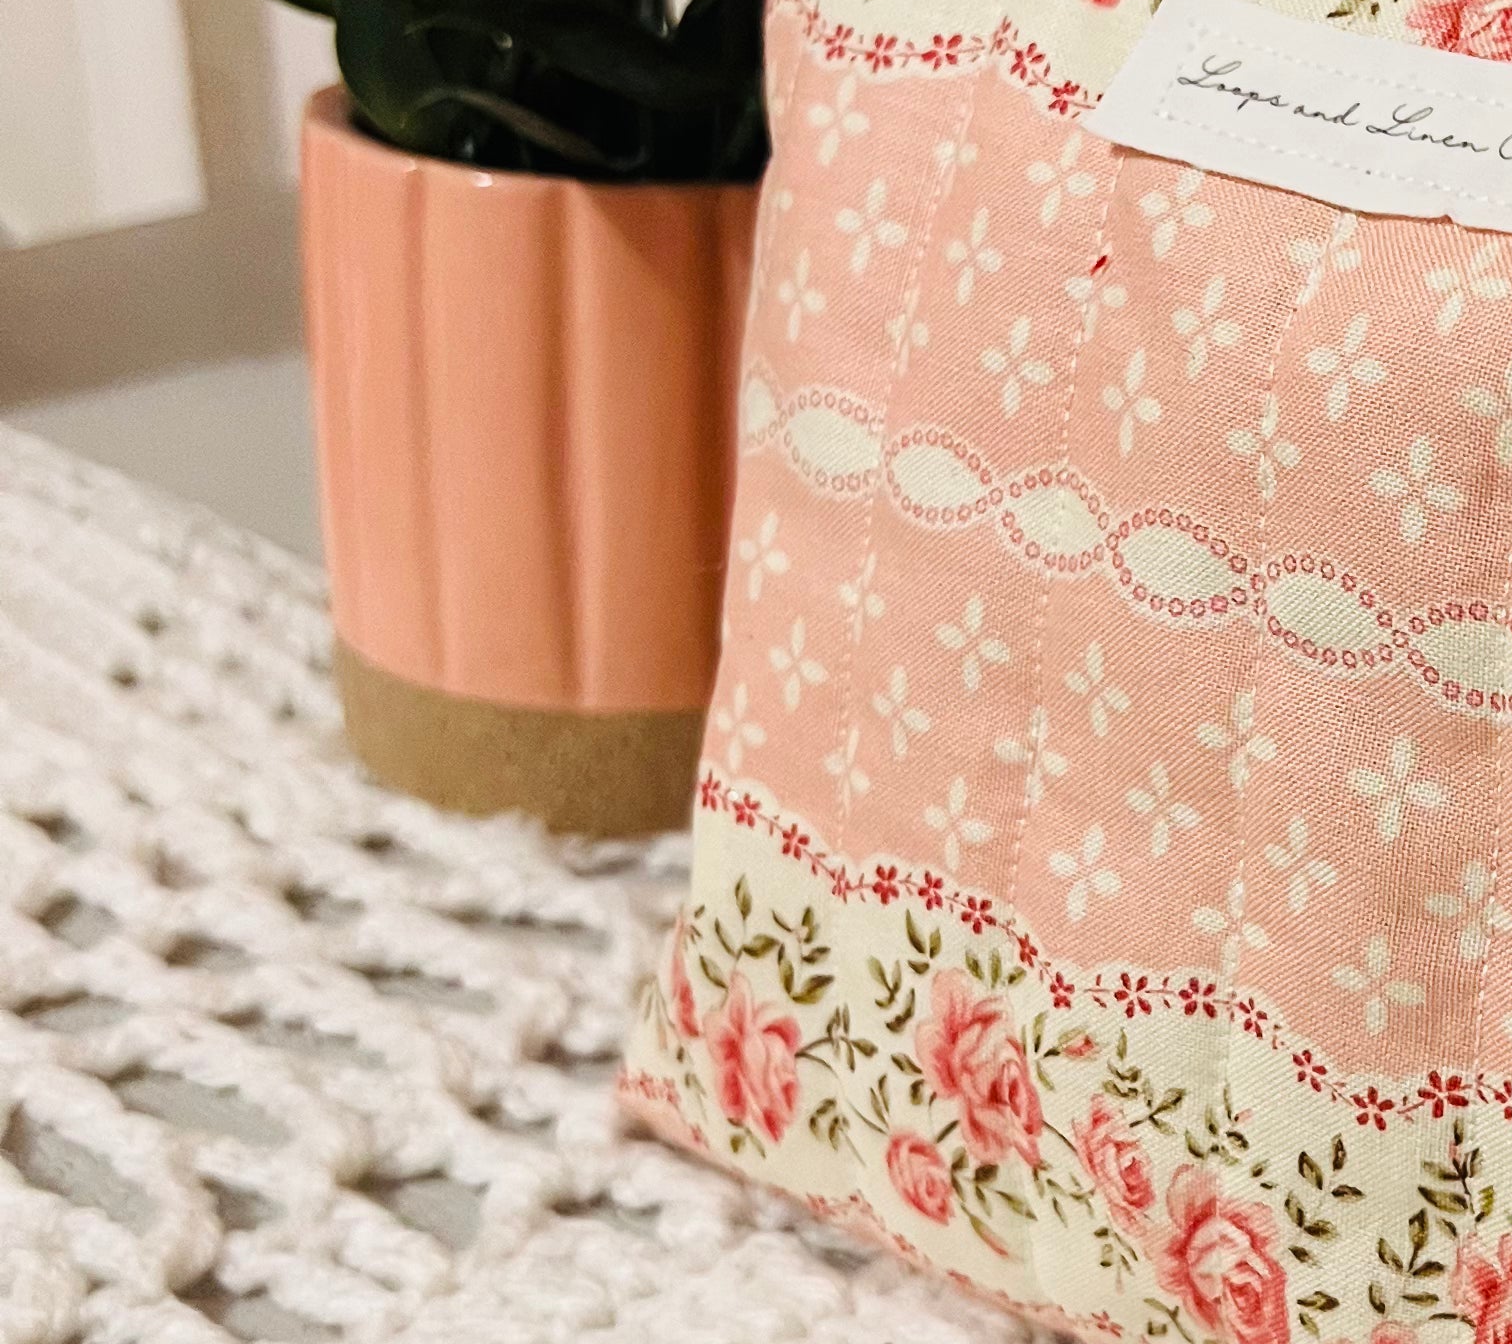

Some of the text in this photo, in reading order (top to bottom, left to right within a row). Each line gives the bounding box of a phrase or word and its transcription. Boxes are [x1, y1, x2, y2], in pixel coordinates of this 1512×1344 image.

[1177, 54, 1289, 111] Loops
[1292, 102, 1360, 127] and
[1366, 103, 1490, 152] Linen
